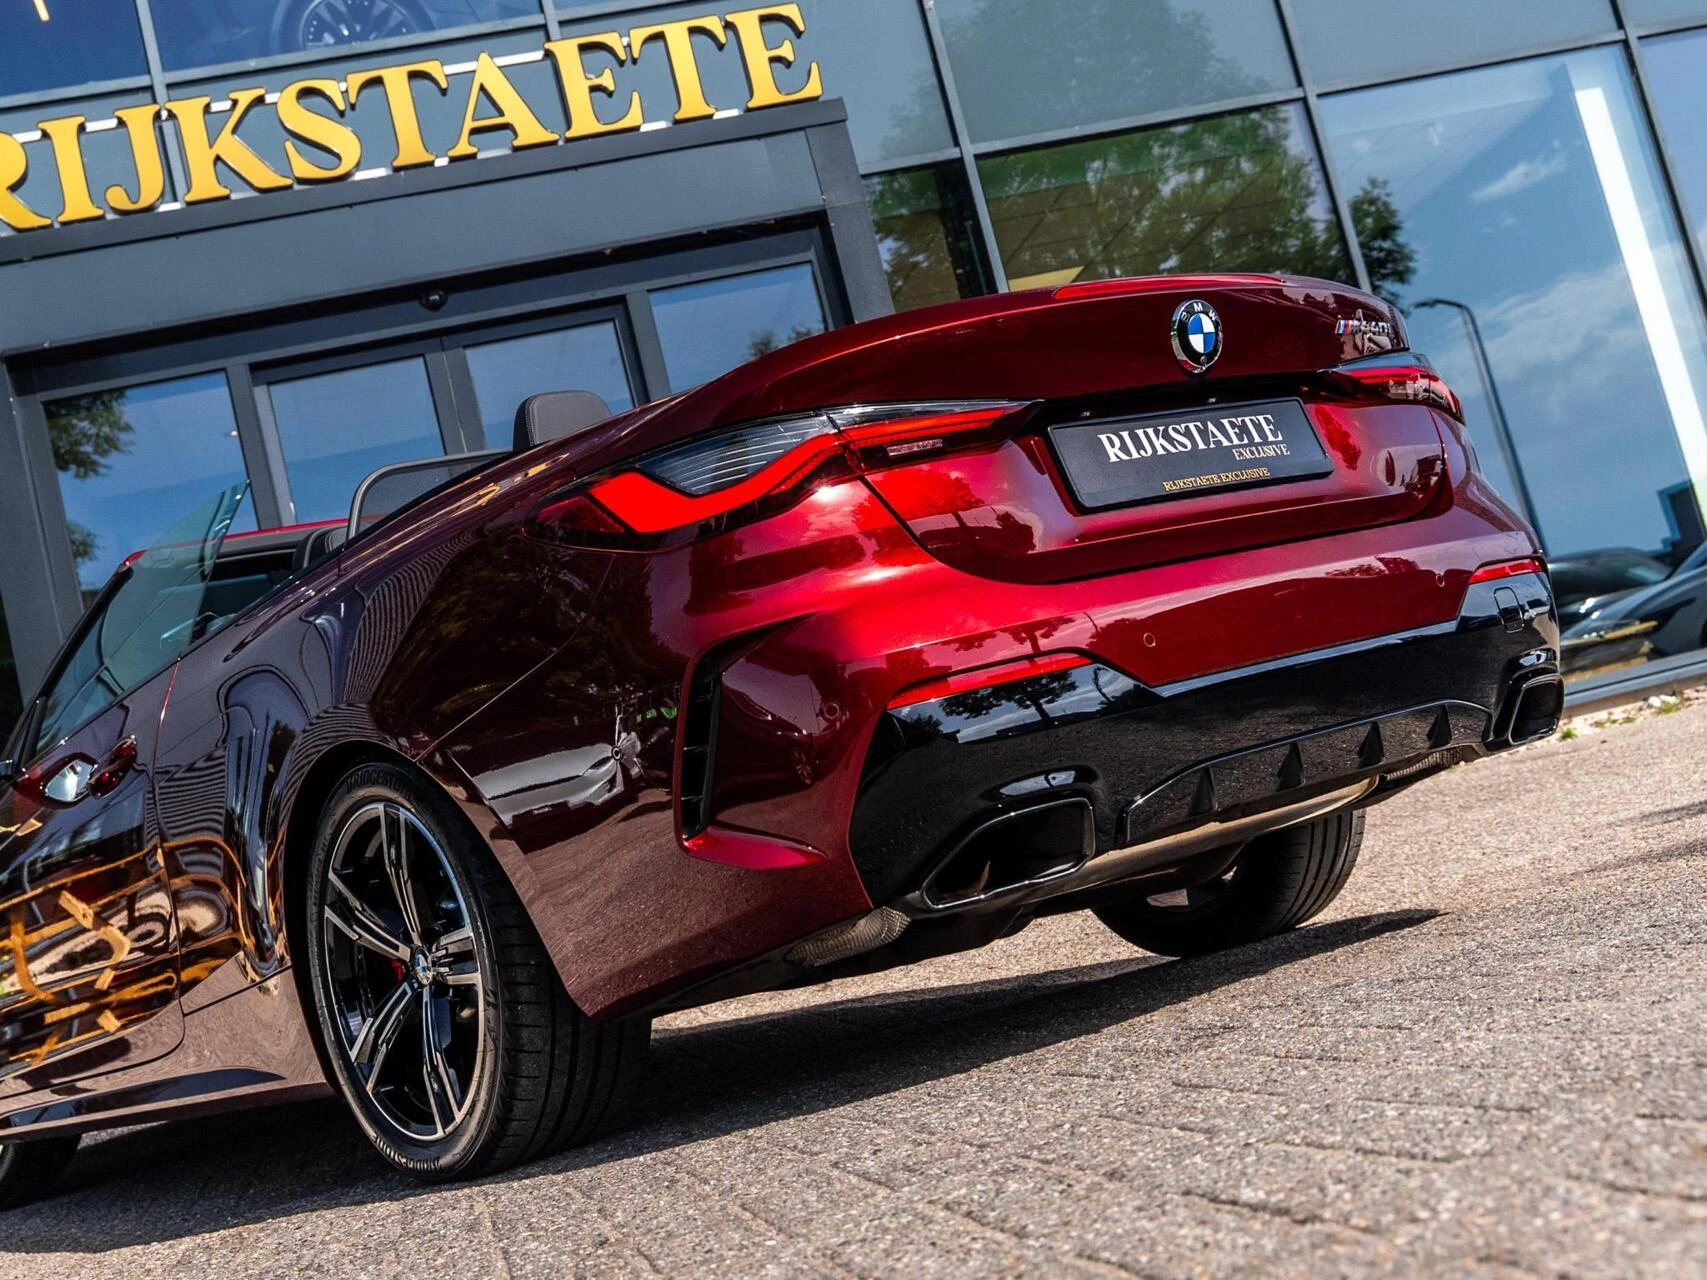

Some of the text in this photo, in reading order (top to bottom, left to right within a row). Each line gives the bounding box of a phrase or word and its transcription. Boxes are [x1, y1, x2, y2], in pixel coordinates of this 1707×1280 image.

[0, 3, 823, 230] RIJKSTAETE
[1180, 302, 1218, 323] BMW
[1097, 415, 1283, 463] RIJKSTAETE
[1232, 443, 1290, 461] EXCLUSIVE
[1163, 467, 1270, 491] RIJKSTAETE EXCLUSIVE
[345, 767, 415, 796] BRIDGESTO
